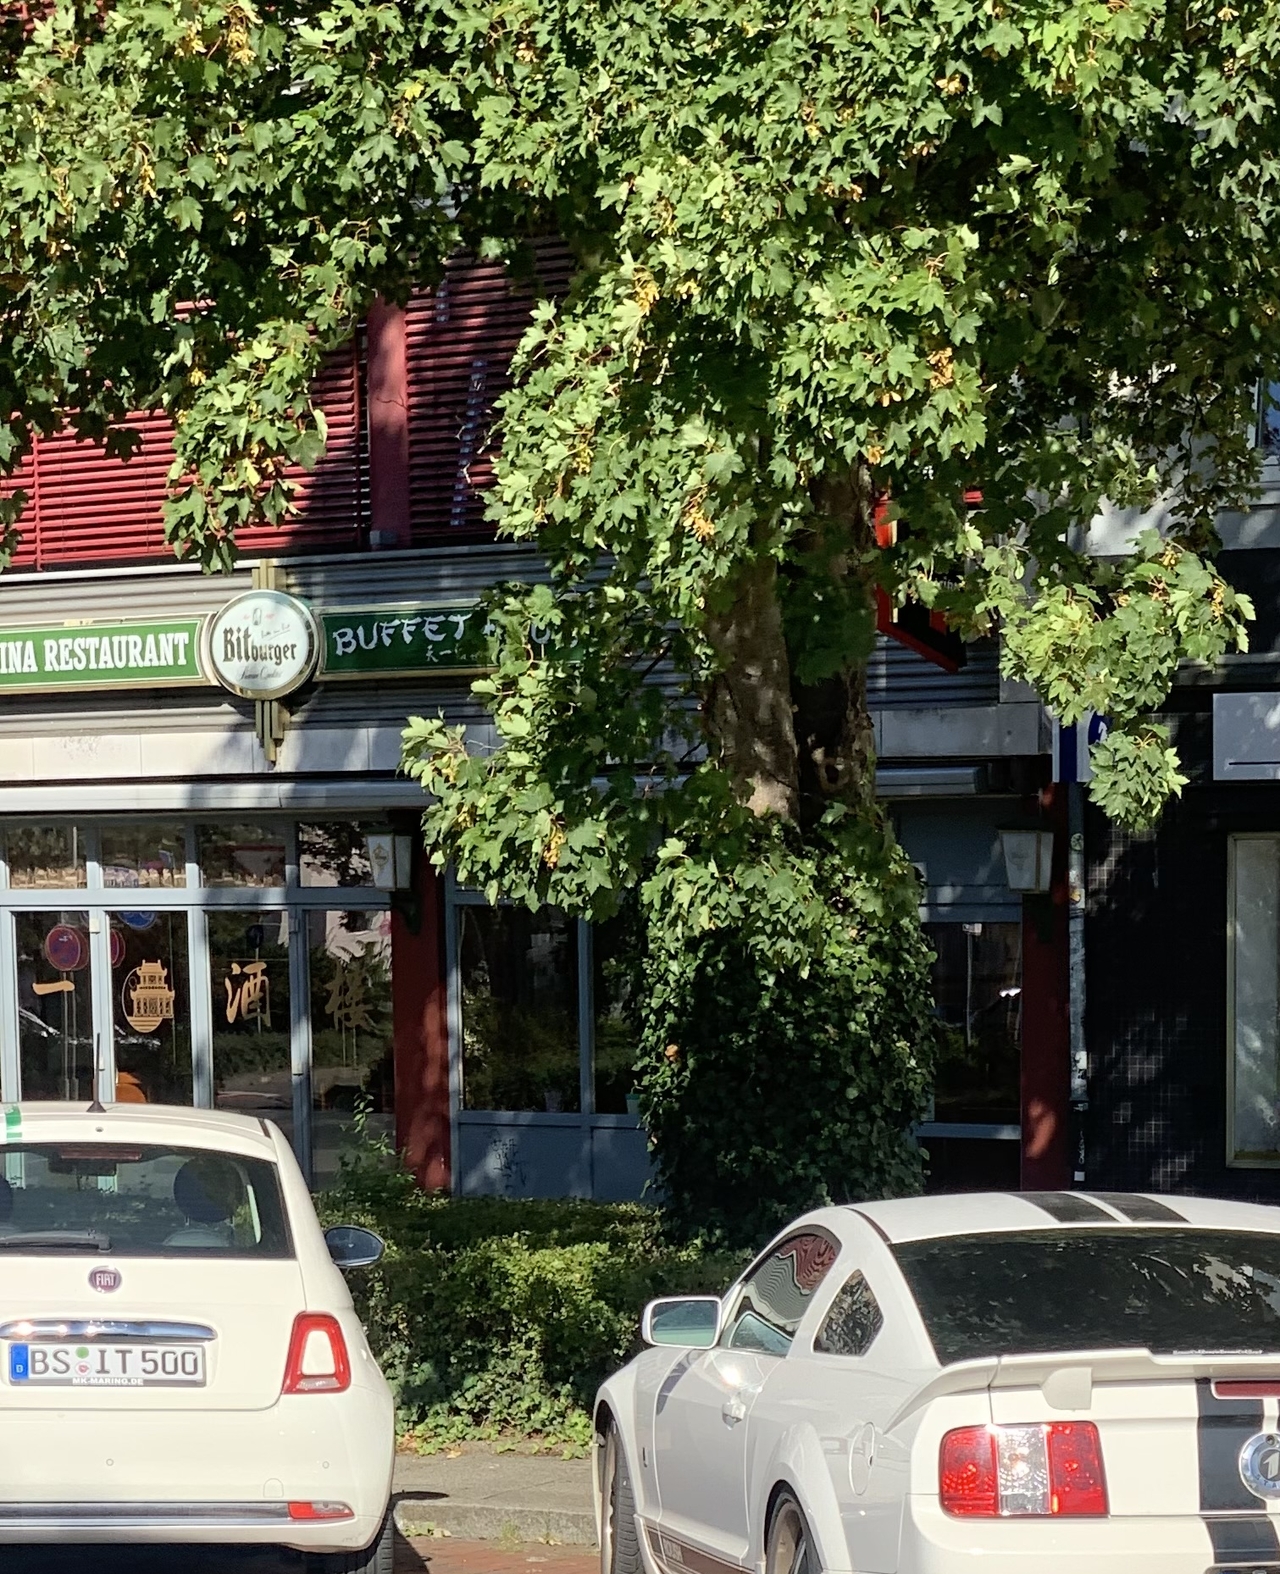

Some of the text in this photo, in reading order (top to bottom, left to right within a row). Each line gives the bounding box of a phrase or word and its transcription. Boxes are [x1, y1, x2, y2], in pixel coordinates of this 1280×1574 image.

[43, 632, 190, 672] RESTAURANT
[222, 626, 298, 666] Bitburger
[332, 612, 473, 656] BUFFET
[95, 1272, 116, 1287] FIAT
[30, 1350, 198, 1376] BS IT 500
